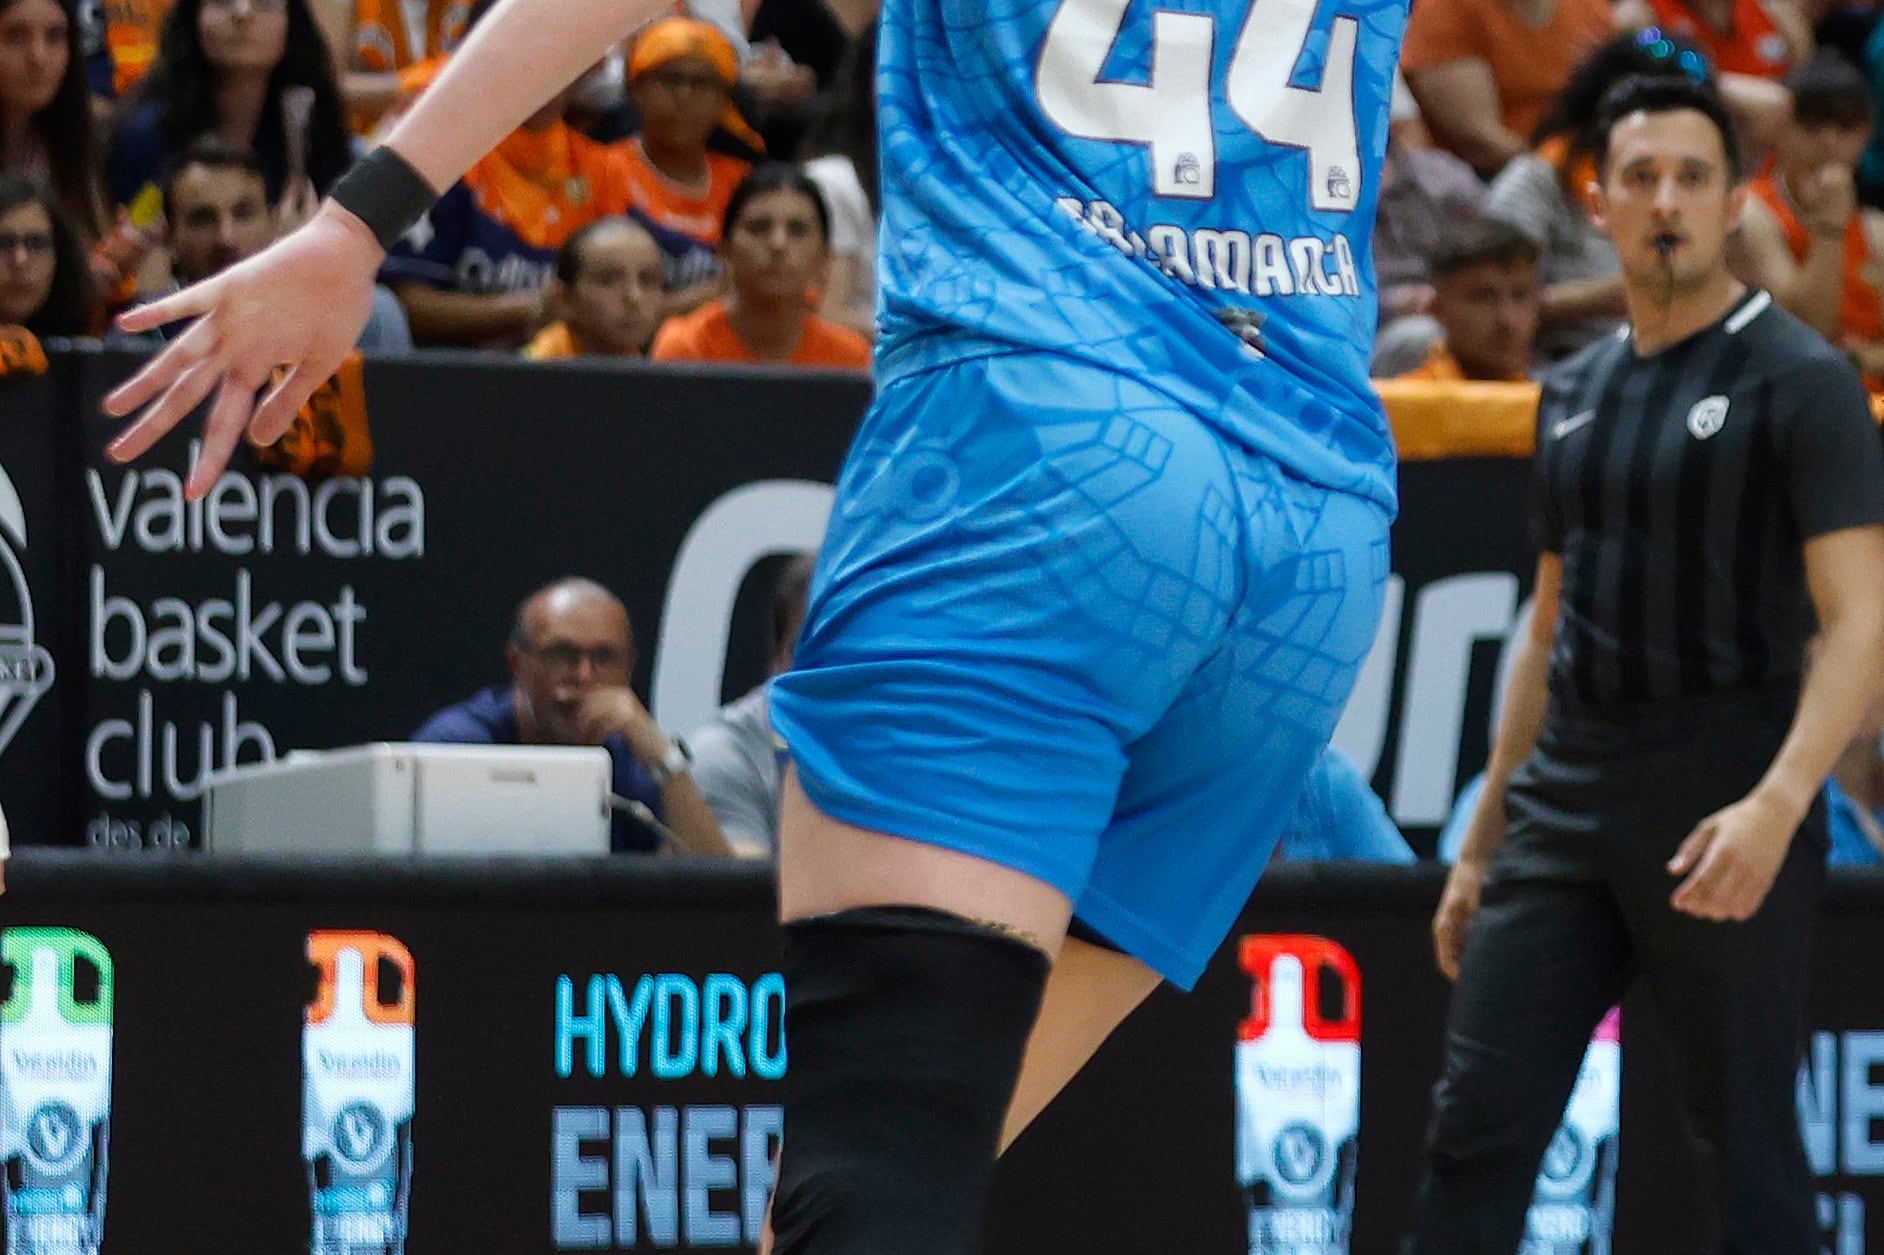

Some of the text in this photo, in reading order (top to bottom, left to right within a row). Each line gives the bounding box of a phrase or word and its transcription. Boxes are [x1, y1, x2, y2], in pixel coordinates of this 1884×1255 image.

[87, 440, 425, 556] valencia
[92, 565, 367, 685] basket
[86, 690, 276, 800] club
[554, 973, 788, 1079] HYDRO
